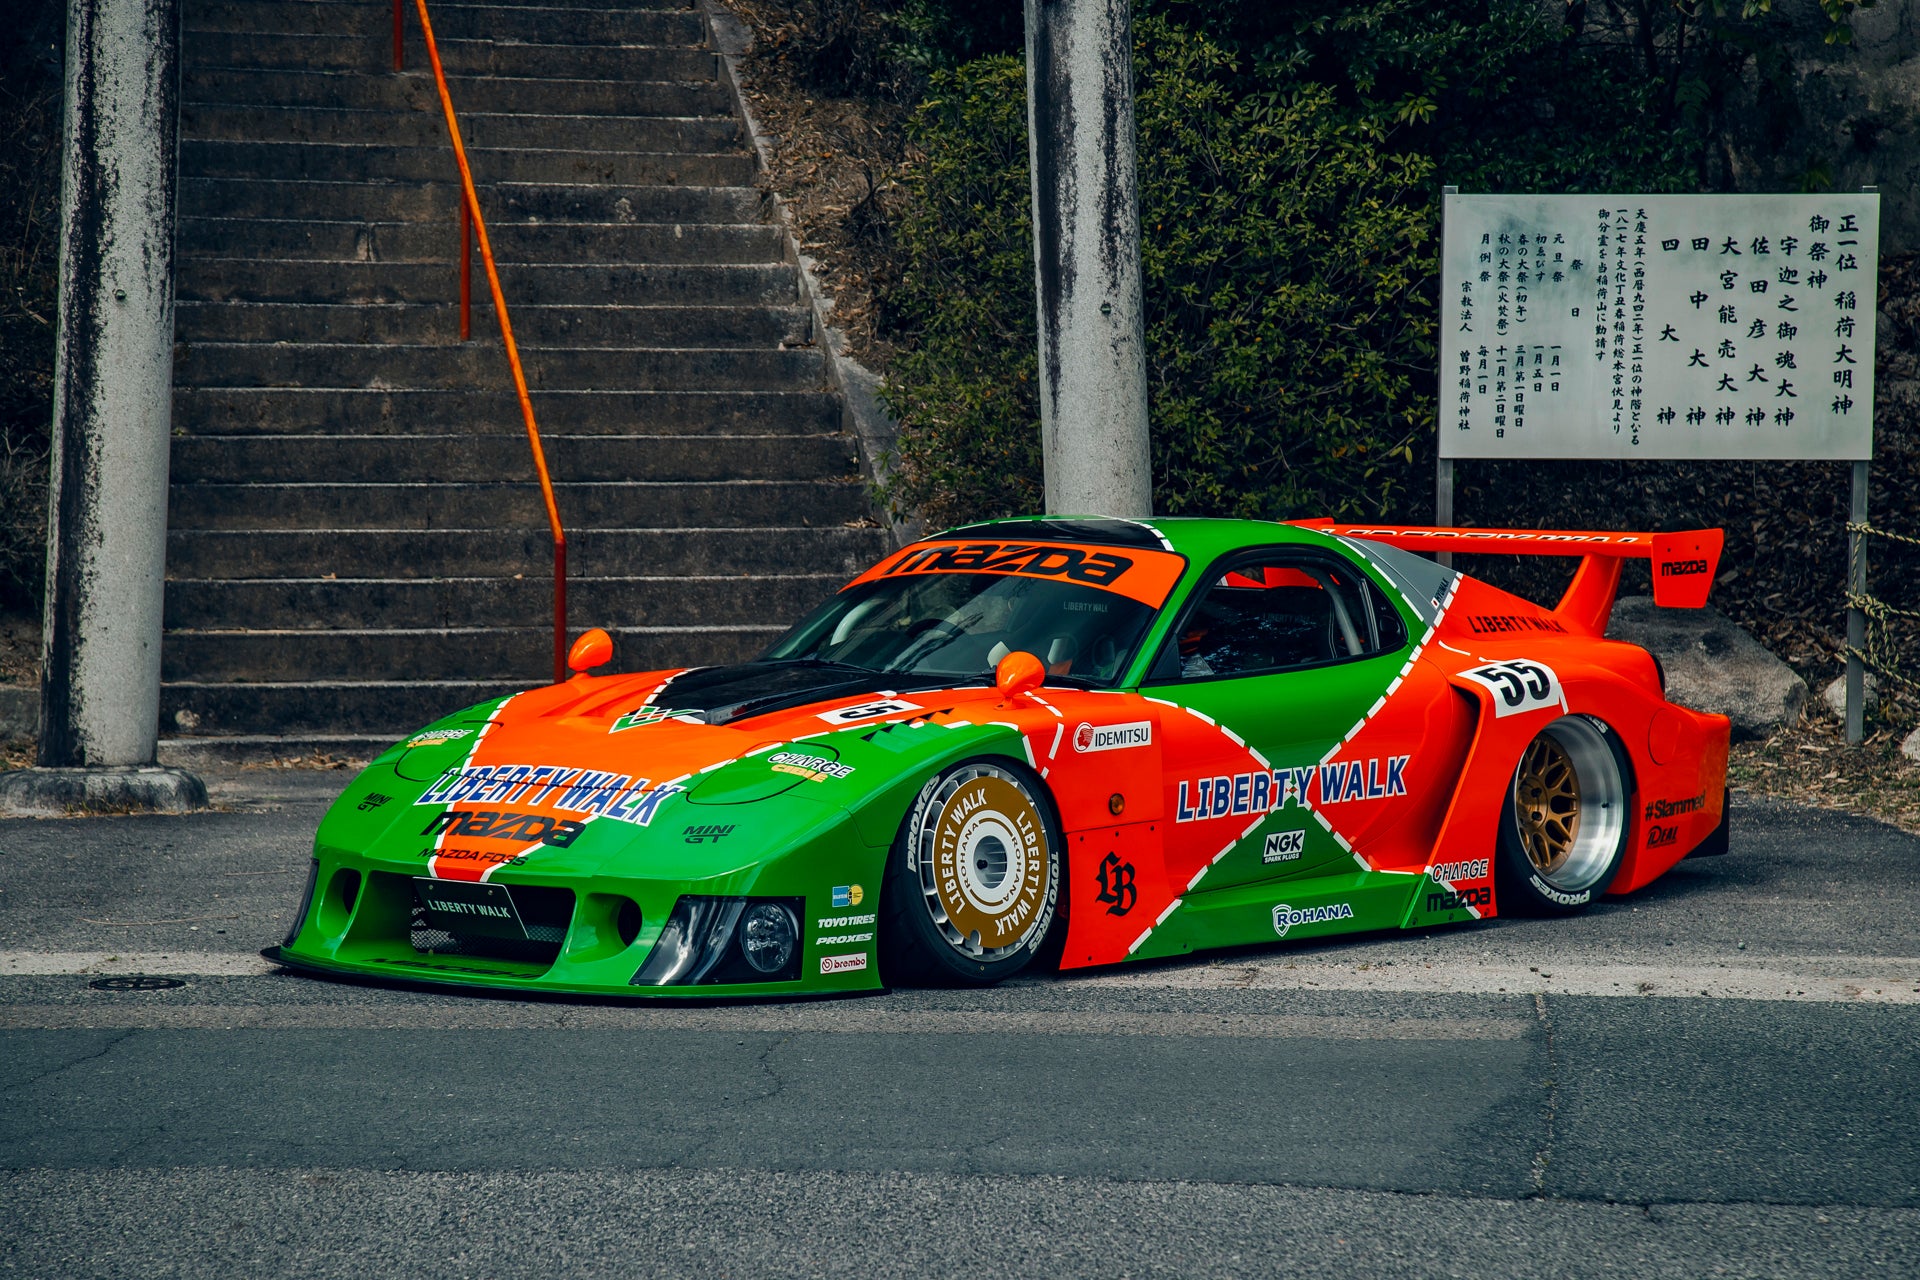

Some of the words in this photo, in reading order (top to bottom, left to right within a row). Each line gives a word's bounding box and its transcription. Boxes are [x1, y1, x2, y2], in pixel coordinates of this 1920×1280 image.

[1478, 232, 1492, 283] 月例祭
[1551, 233, 1565, 283] 元旦祭
[1806, 214, 1831, 290] 御祭神
[1834, 214, 1859, 272] 正一位
[1459, 280, 1474, 333] 宗教法人
[1714, 235, 1743, 426] 大宮能売大神
[1656, 238, 1681, 426] 四大神
[1685, 236, 1710, 427] 田中大神
[1744, 235, 1771, 427] 佐田彦大神
[1773, 235, 1801, 427] 宇迦之御魂大神
[1831, 290, 1858, 416] 稲荷大明神
[1476, 344, 1490, 395] 毎月一日
[1494, 344, 1508, 439] 十一月第二日曜日
[1513, 344, 1527, 428] 三月第一日曜日
[1532, 345, 1545, 393] 一月五日
[1549, 345, 1562, 392] 一月一日
[1063, 601, 1091, 612] LIBERTY
[1467, 616, 1532, 633] LIBERTY
[1526, 617, 1569, 634] WALK
[1473, 662, 1551, 707] 55
[1095, 727, 1149, 747] IDEMITSU
[768, 752, 856, 779] CHARGE
[1176, 766, 1316, 823] LIBERTY
[1319, 754, 1411, 805] WALK
[357, 801, 381, 812] GT
[363, 792, 393, 804] MINI
[413, 765, 580, 806] LIBERTY
[552, 769, 687, 827] WALK
[950, 788, 988, 826] WALK
[1645, 790, 1706, 821] #Slammed
[682, 824, 736, 835] MINI
[685, 834, 728, 844] GT
[907, 775, 940, 873] PROXES
[1265, 832, 1304, 855] NGK
[417, 848, 480, 862] MAZDA
[478, 852, 530, 867] FD3S
[941, 823, 966, 914] LIBERTY
[959, 822, 980, 889] ROHANA
[1003, 837, 1022, 902] ROHANA
[1016, 811, 1040, 900] LIBERTY
[1049, 851, 1060, 905] TOYO
[1264, 855, 1281, 864] SPARK
[1282, 852, 1300, 862] PLUGS
[1432, 858, 1489, 883] CHARGE
[428, 900, 476, 914] LIBERTY
[477, 904, 511, 918] WALK
[1529, 874, 1591, 905] PROXES
[816, 933, 873, 945] PROXES
[818, 916, 847, 928] TOYO
[848, 914, 876, 925] TIRES
[994, 899, 1032, 936] WALK
[1027, 905, 1054, 954] TIRES
[1276, 903, 1354, 928] ROHANA
[834, 957, 866, 969] brembo
